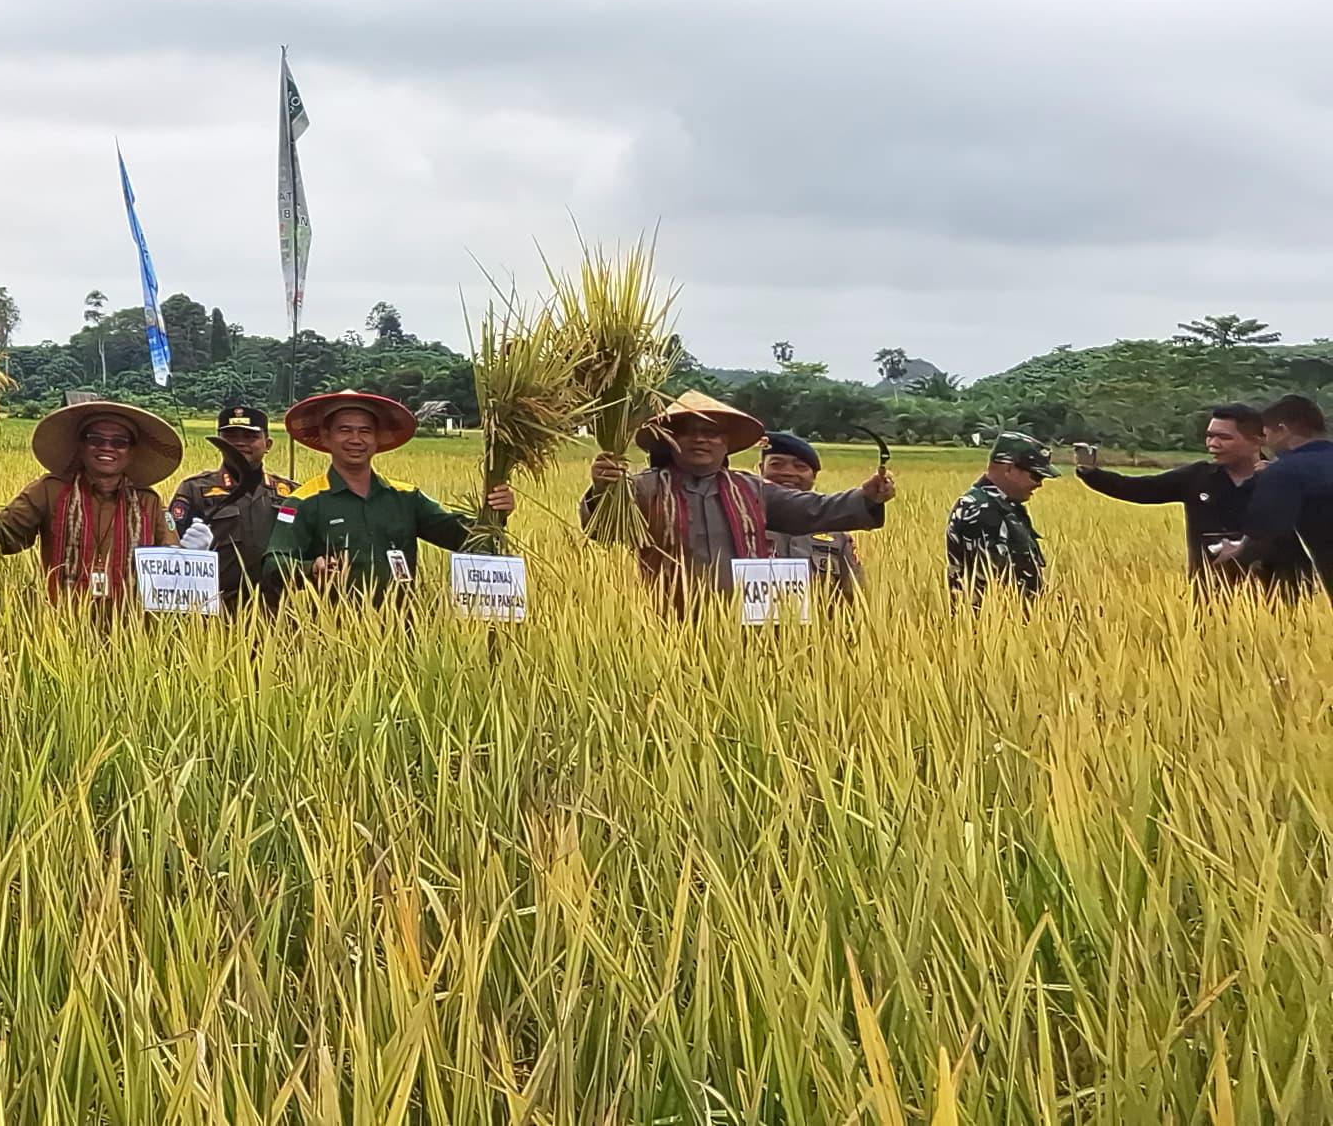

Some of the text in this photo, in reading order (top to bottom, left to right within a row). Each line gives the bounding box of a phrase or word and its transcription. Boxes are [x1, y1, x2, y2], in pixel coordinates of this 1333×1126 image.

[141, 559, 214, 578] KEPALA DINAS
[151, 587, 209, 605] PERTANIAN
